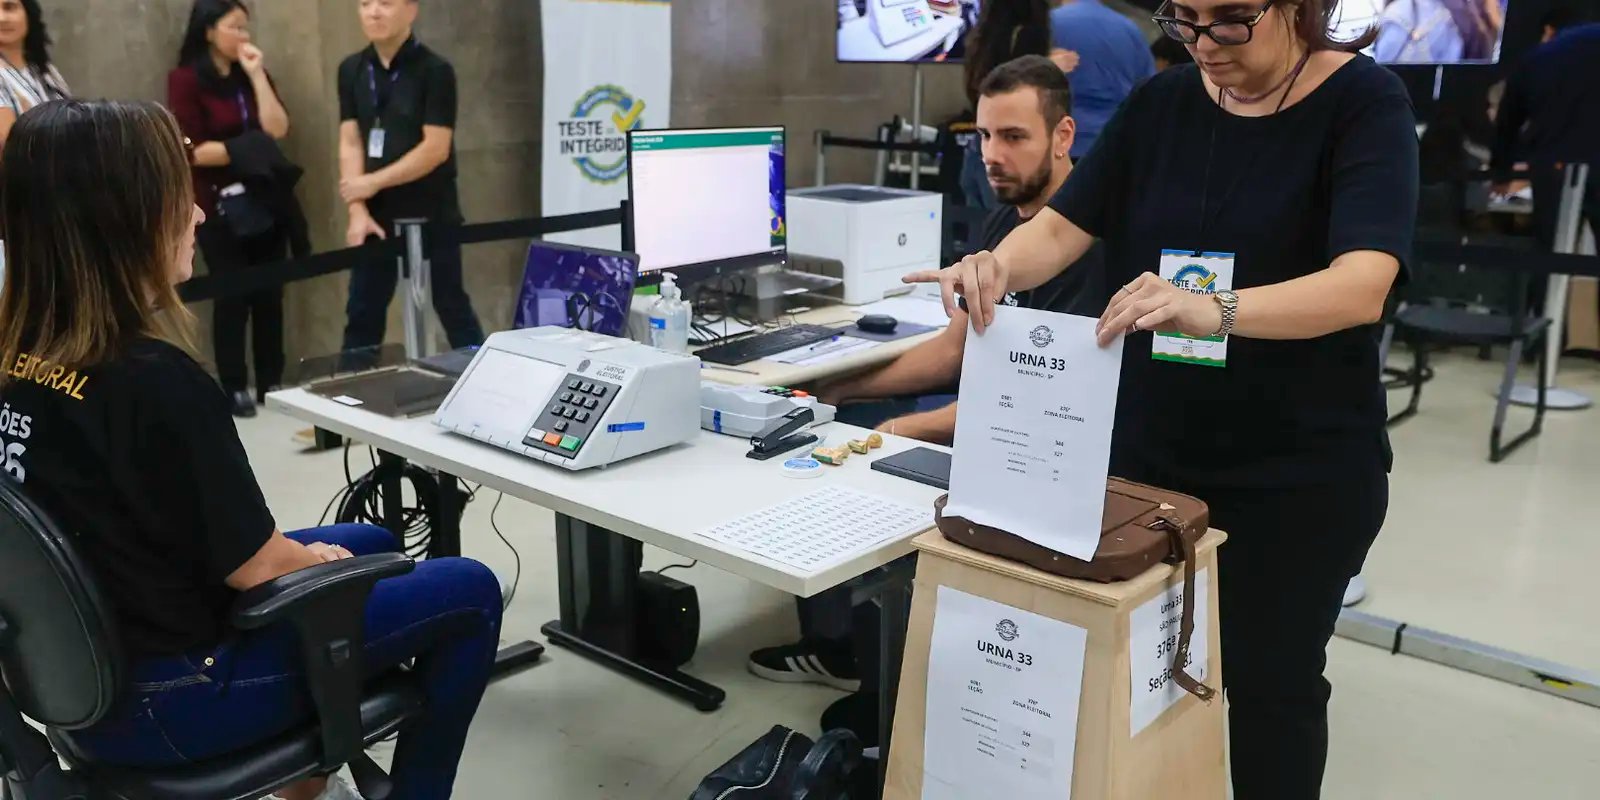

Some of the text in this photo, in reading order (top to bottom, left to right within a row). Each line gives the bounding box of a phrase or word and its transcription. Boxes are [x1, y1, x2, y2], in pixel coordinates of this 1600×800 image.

[558, 120, 602, 136] TESTE
[1009, 351, 1066, 371] URNA 33
[8, 353, 88, 400] EITORAL
[1161, 594, 1182, 614] Urna 33
[977, 639, 1033, 666] URNA 33
[1157, 635, 1176, 659] 376ª
[1148, 668, 1173, 692] Seção
